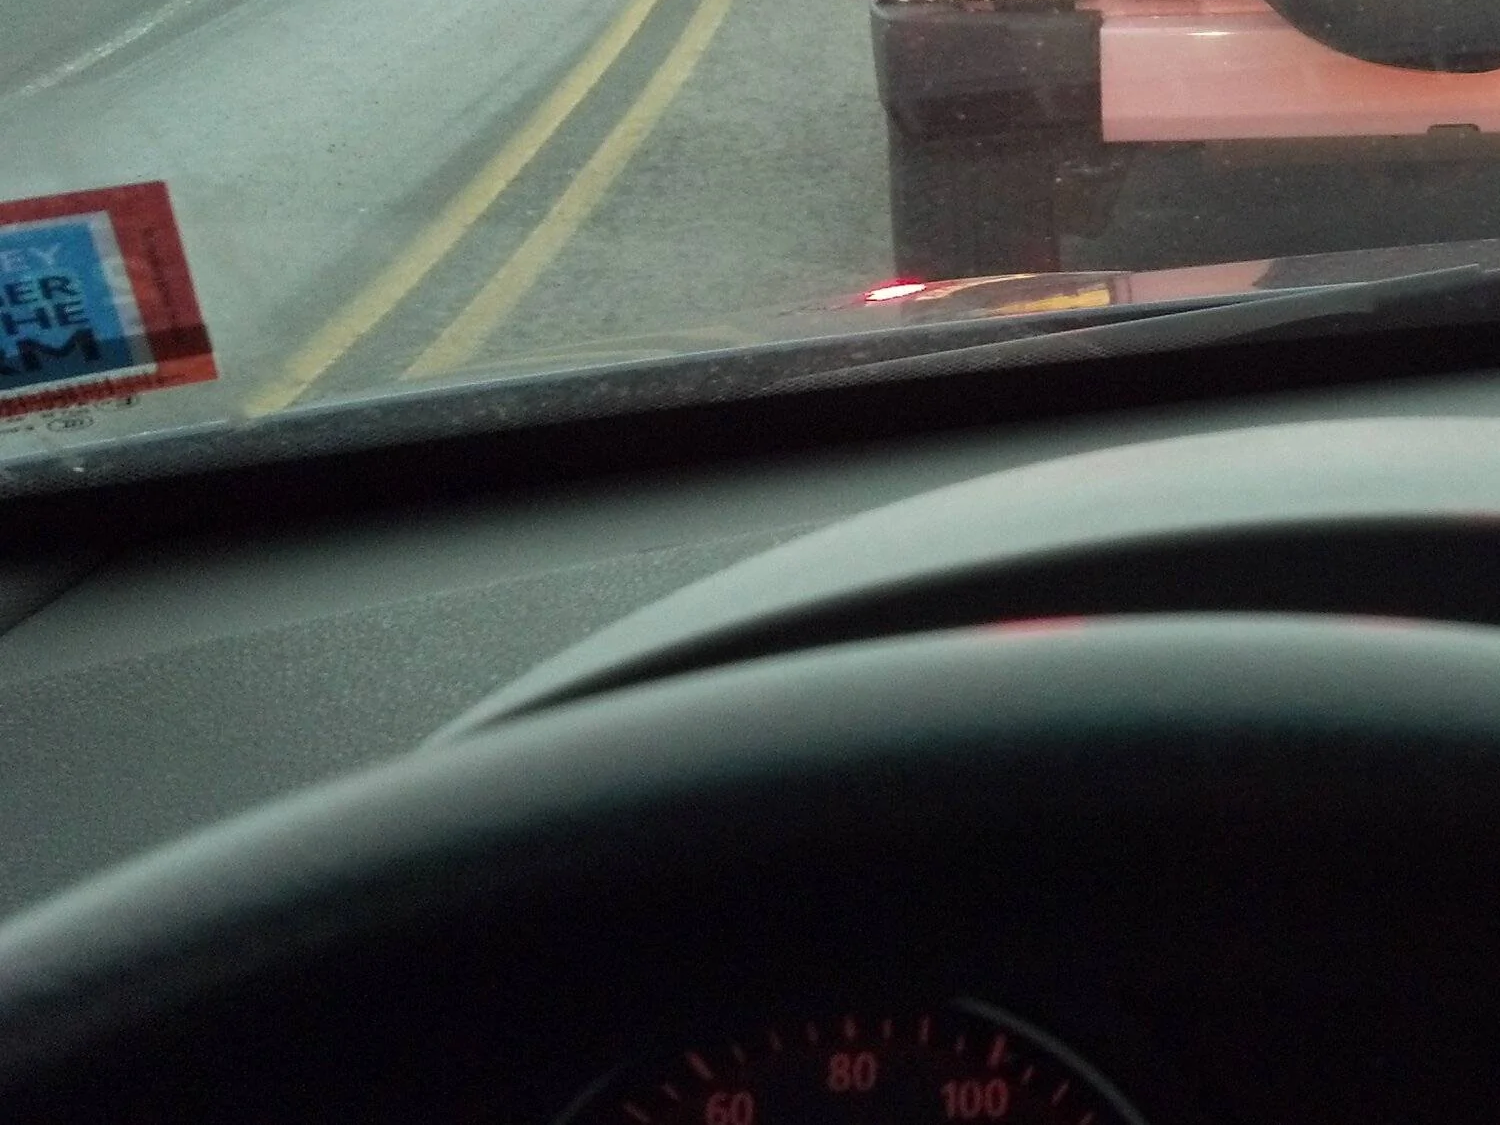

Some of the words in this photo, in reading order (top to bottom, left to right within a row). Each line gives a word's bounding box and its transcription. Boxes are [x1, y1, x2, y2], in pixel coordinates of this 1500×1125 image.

[827, 1052, 877, 1092] 80
[706, 1091, 756, 1125] 60
[942, 1078, 1010, 1120] 100
